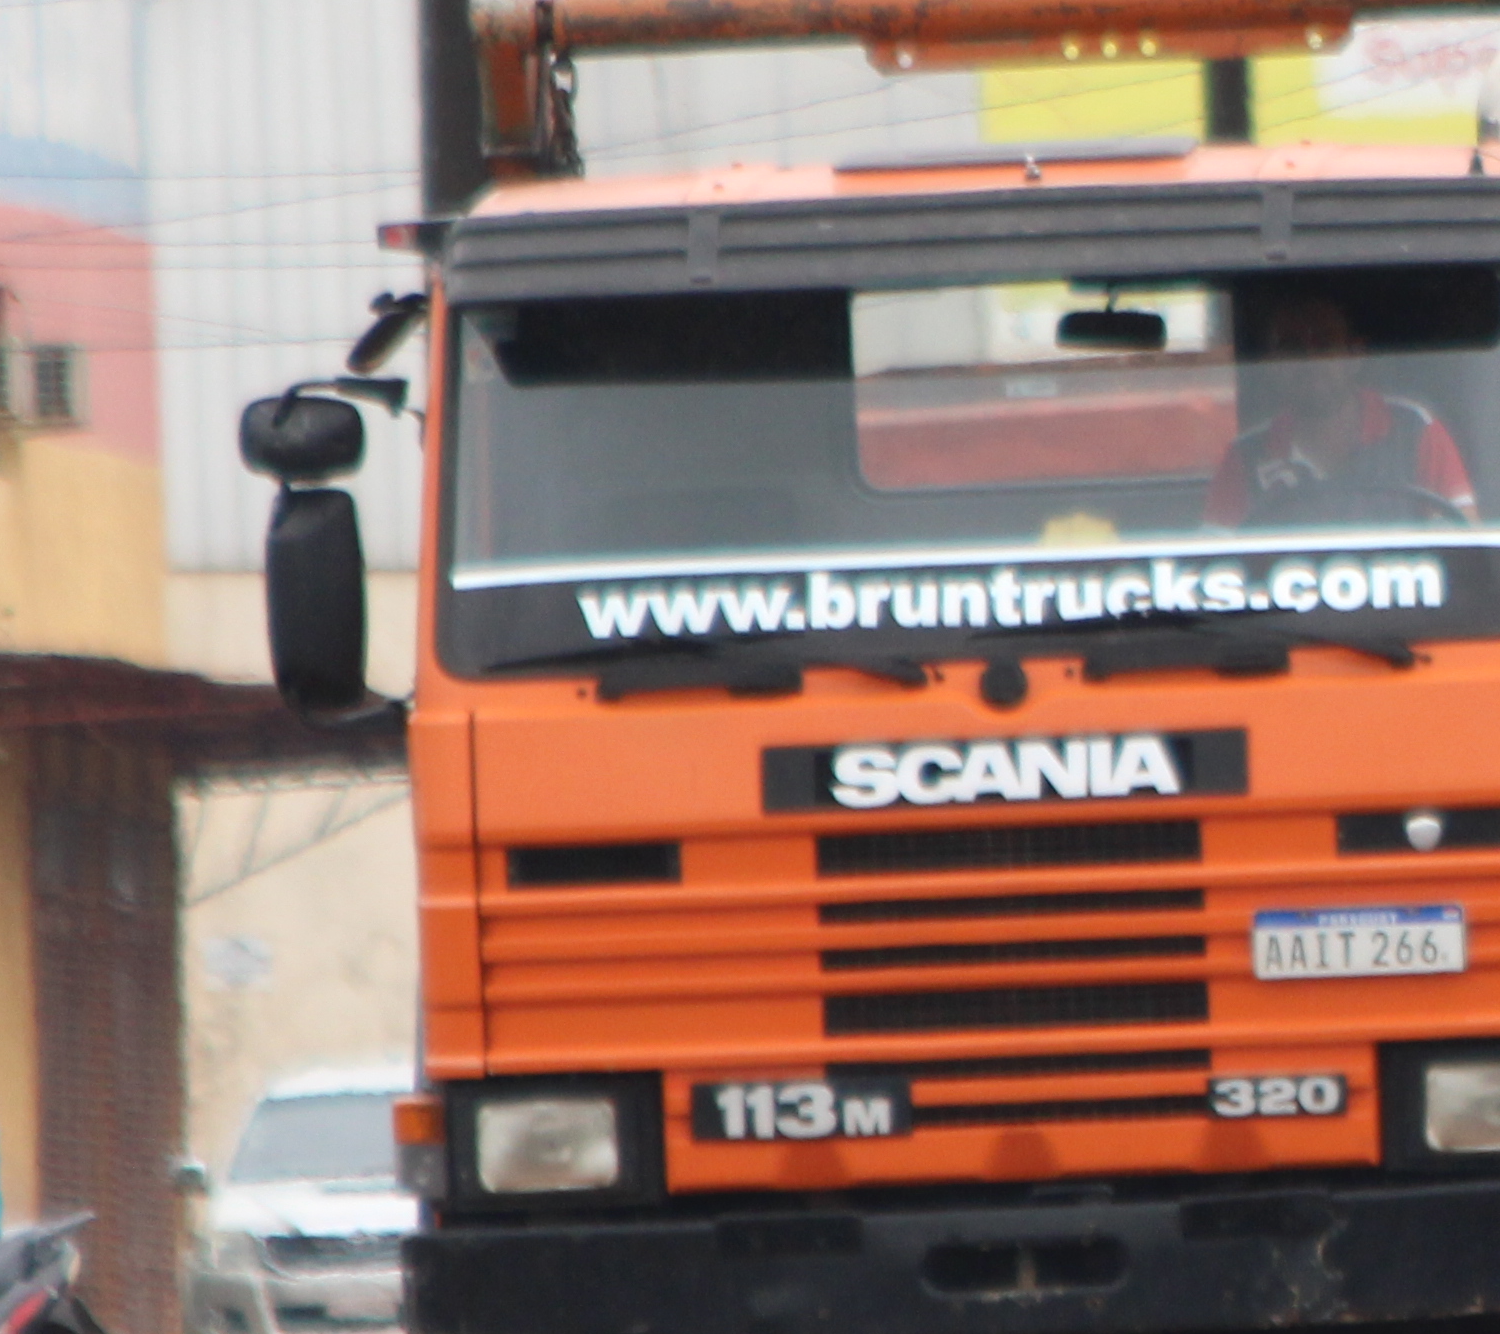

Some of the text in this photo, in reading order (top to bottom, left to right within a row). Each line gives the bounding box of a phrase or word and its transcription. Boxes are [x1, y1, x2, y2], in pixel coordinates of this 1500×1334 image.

[576, 558, 1444, 639] www.bruntrucks.com
[831, 734, 1181, 809] SCANIA
[1266, 929, 1438, 969] AAIT 266
[1213, 1076, 1341, 1117] 320
